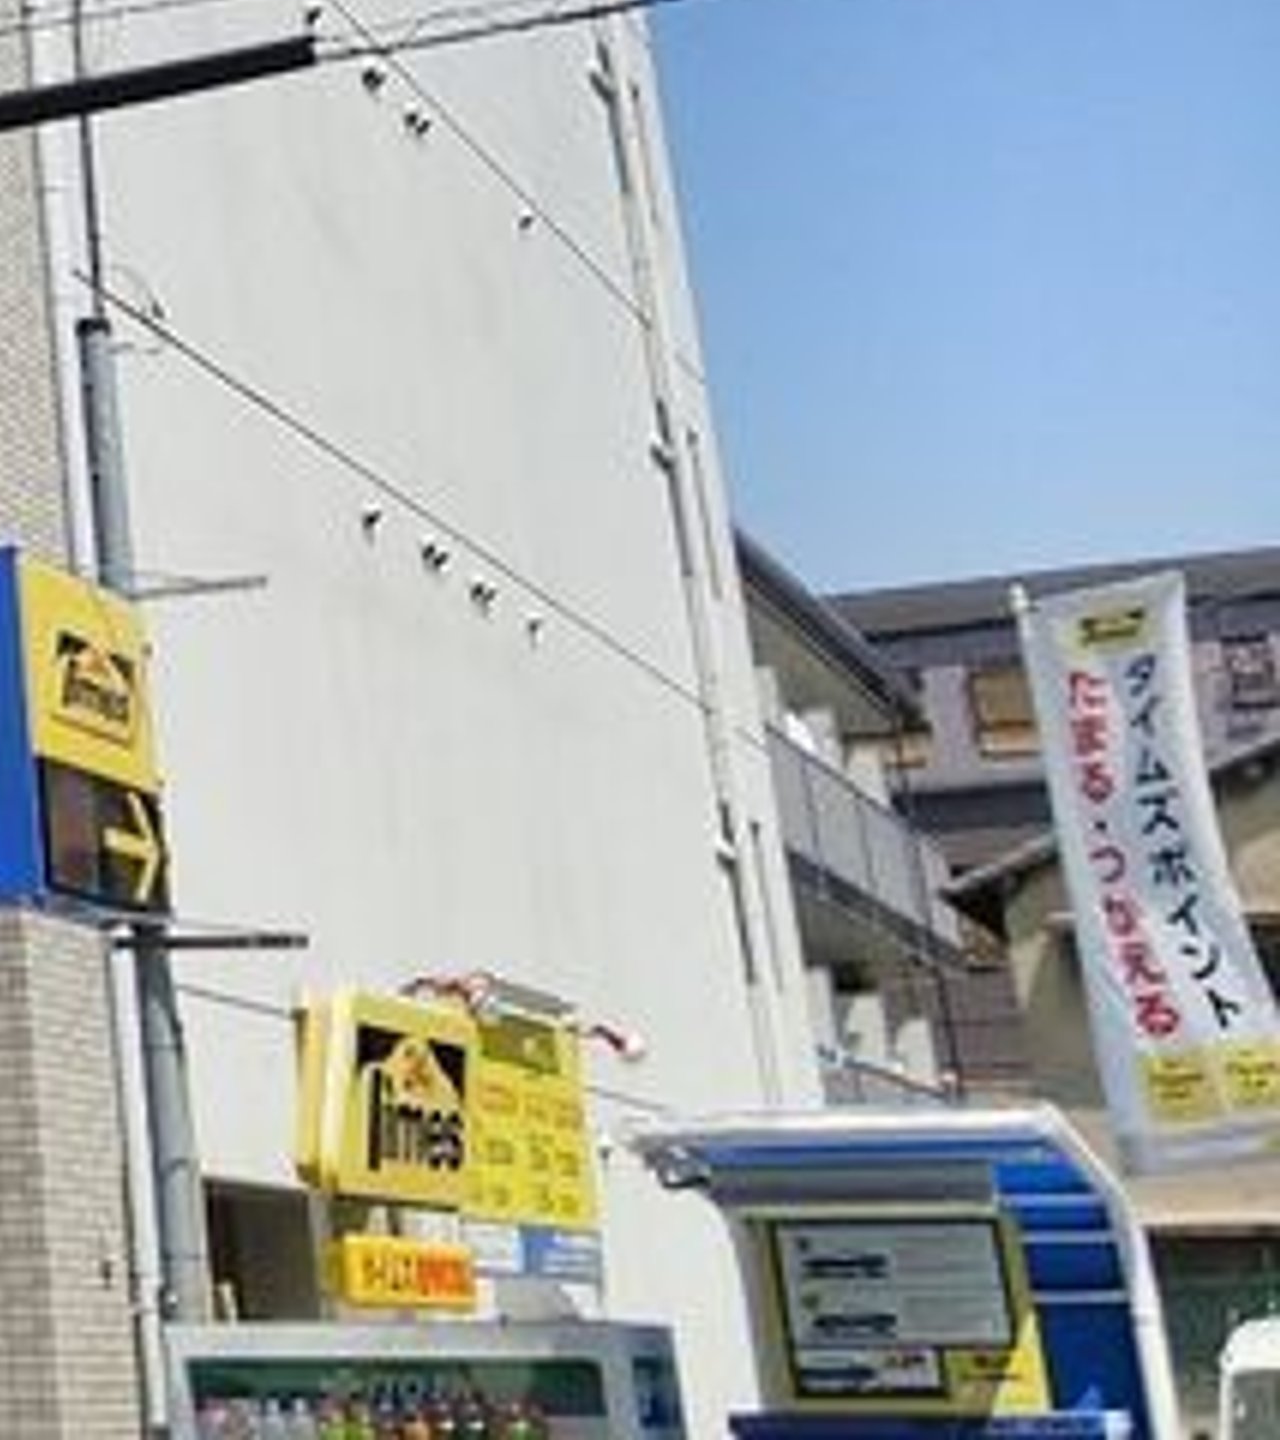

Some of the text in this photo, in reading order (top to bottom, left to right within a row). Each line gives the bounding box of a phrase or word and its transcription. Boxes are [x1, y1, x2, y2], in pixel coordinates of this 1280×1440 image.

[1124, 653, 1241, 1030] タイムズポイント
[357, 1026, 466, 1171] Times
